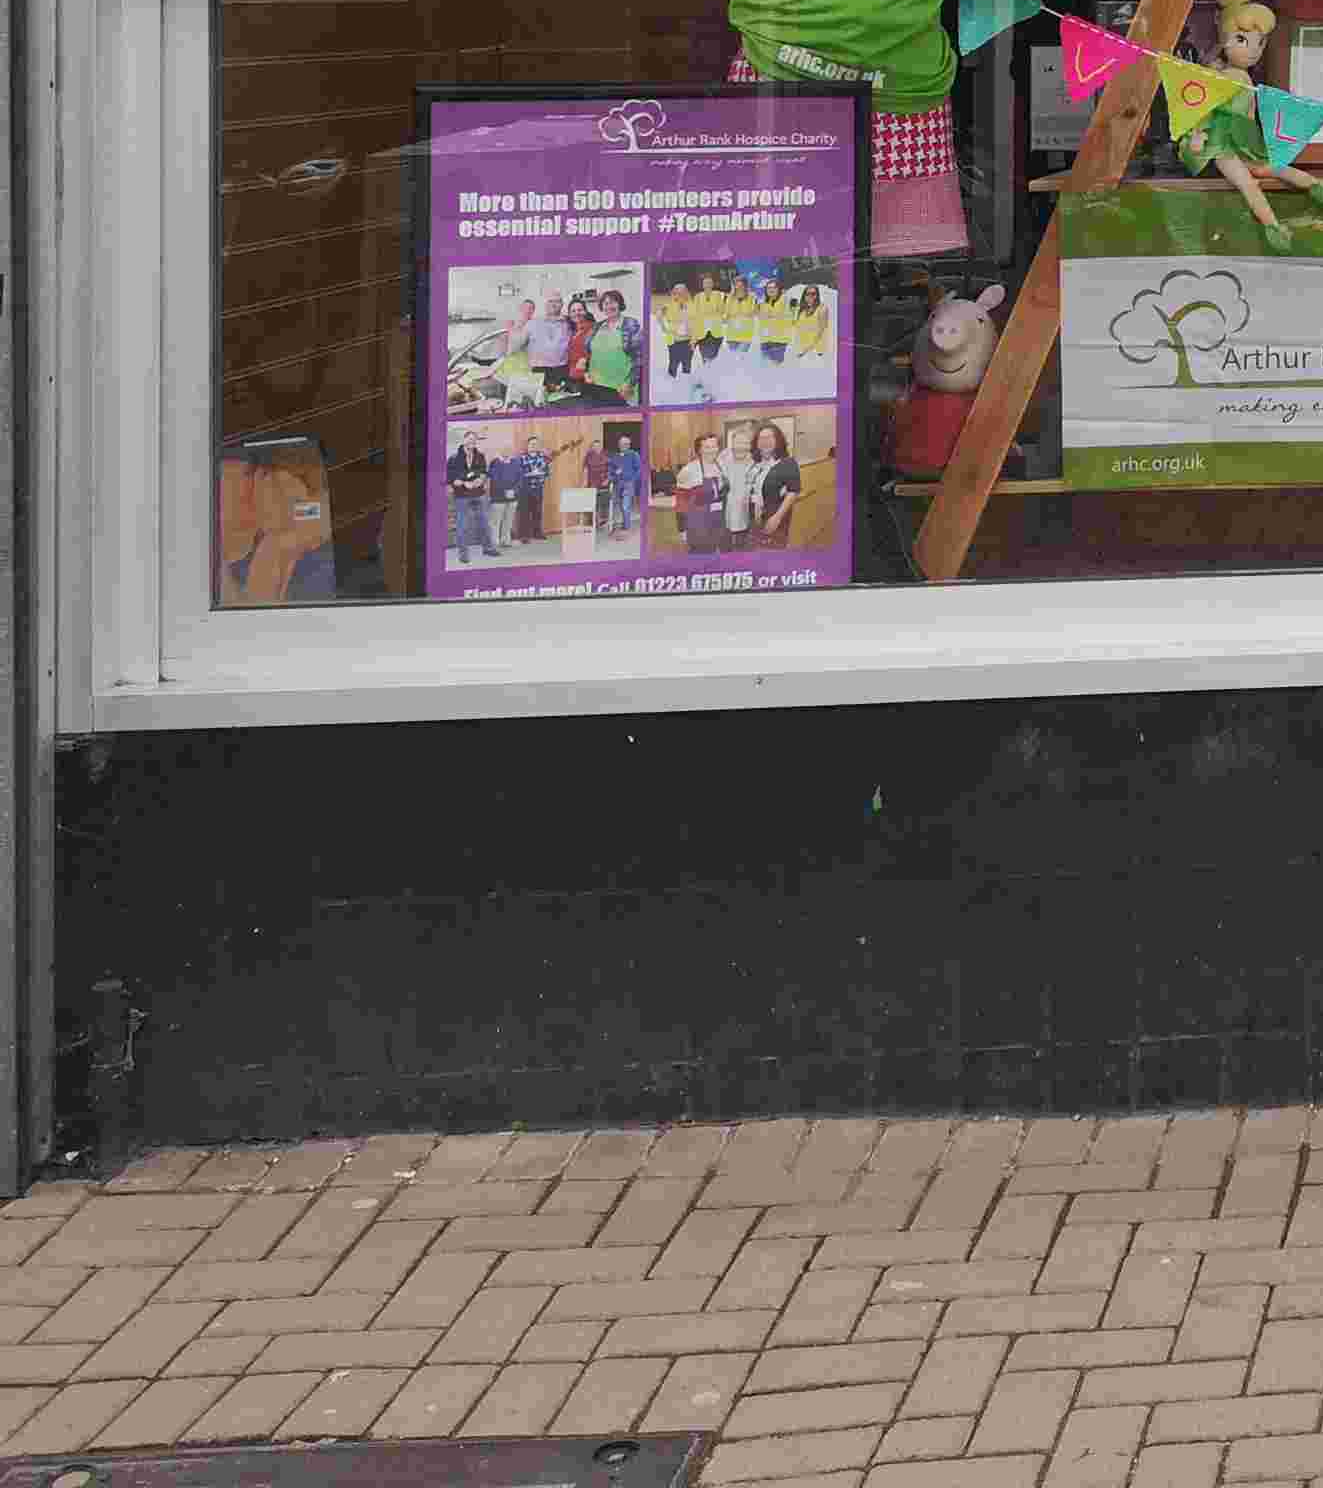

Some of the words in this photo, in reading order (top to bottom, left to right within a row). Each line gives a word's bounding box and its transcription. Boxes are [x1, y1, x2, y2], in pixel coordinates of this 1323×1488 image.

[651, 133, 697, 146] Arthur
[699, 133, 734, 146] Rank
[735, 133, 788, 149] Hospice
[790, 131, 838, 147] Charity
[458, 192, 515, 213] More
[517, 191, 569, 212] than
[573, 190, 615, 210] 500
[618, 187, 733, 209] volunteers
[736, 186, 817, 210] provide
[458, 214, 561, 237] essential
[564, 213, 651, 237] support
[655, 210, 798, 234] #TeamArthur
[1221, 344, 1312, 370] Arthur
[1216, 396, 1304, 424] making
[1110, 451, 1207, 475] arhc.org.uk
[597, 580, 632, 595] Call
[634, 578, 686, 594] 01223
[758, 575, 780, 587] or
[781, 569, 818, 586] visit
